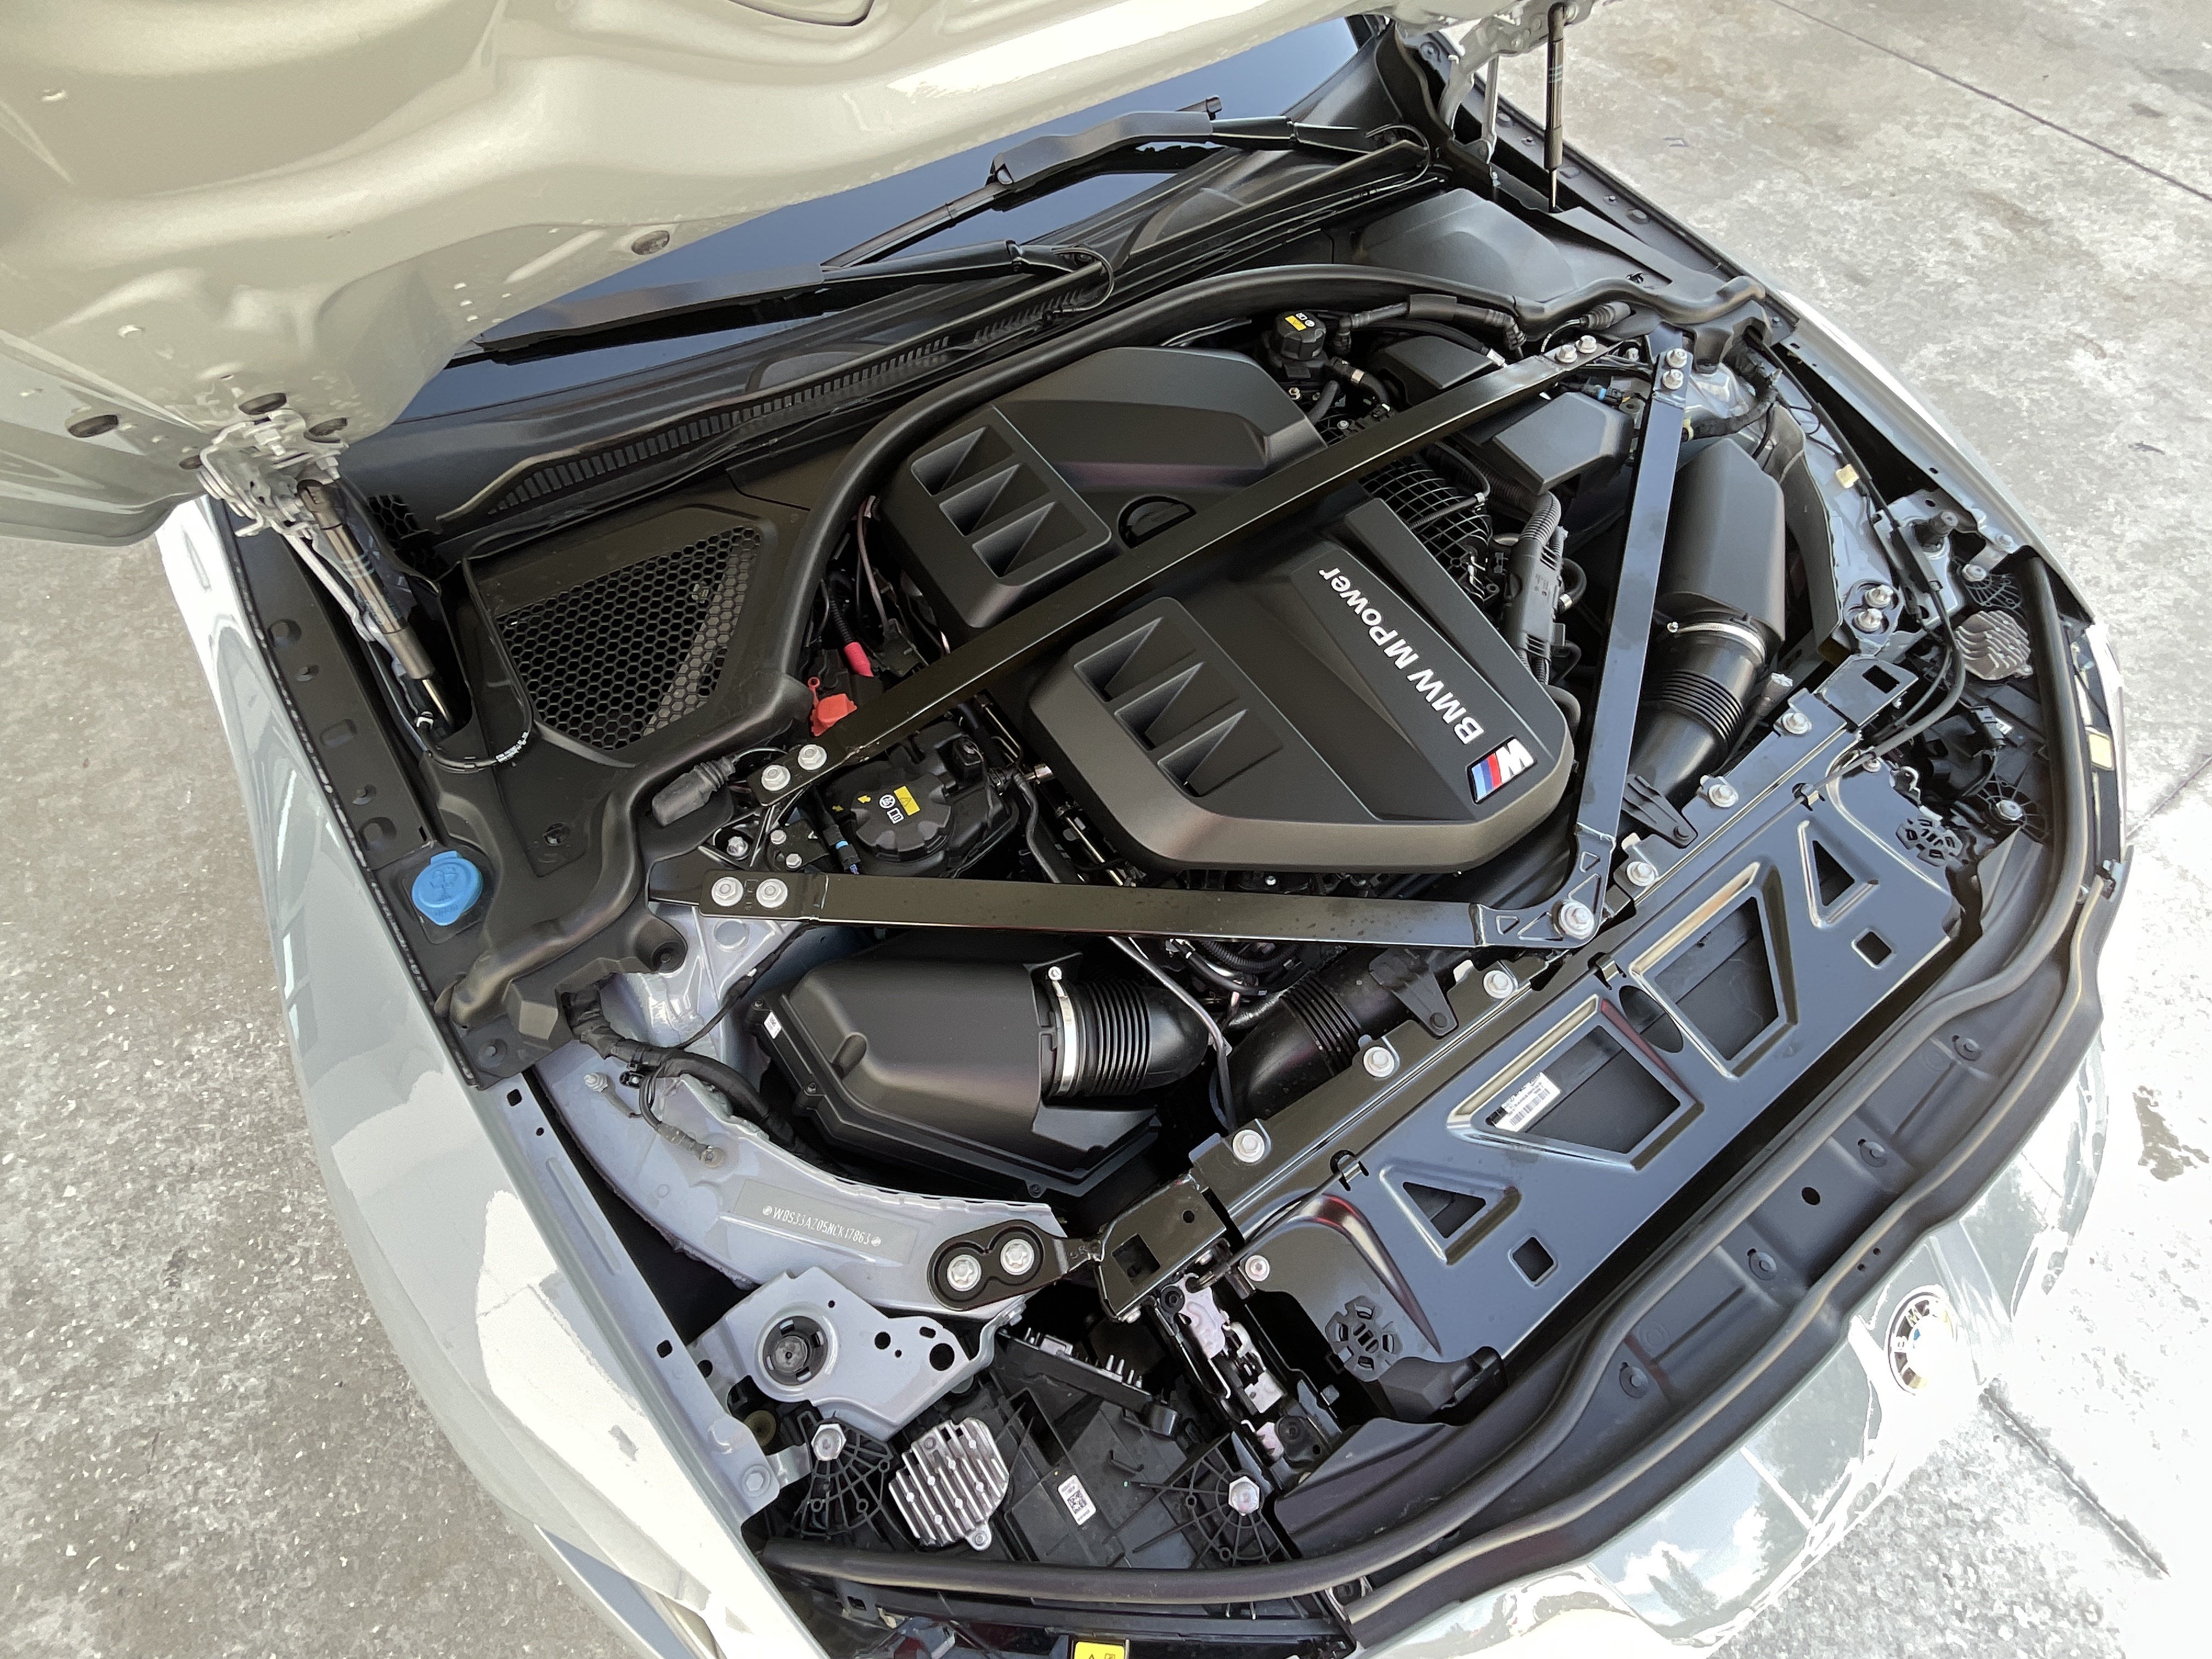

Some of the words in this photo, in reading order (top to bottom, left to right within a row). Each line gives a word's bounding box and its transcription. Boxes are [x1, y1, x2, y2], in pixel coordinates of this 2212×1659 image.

[1319, 568, 1419, 669] MPower
[1407, 669, 1484, 744] BMW
[1496, 738, 1534, 783] M
